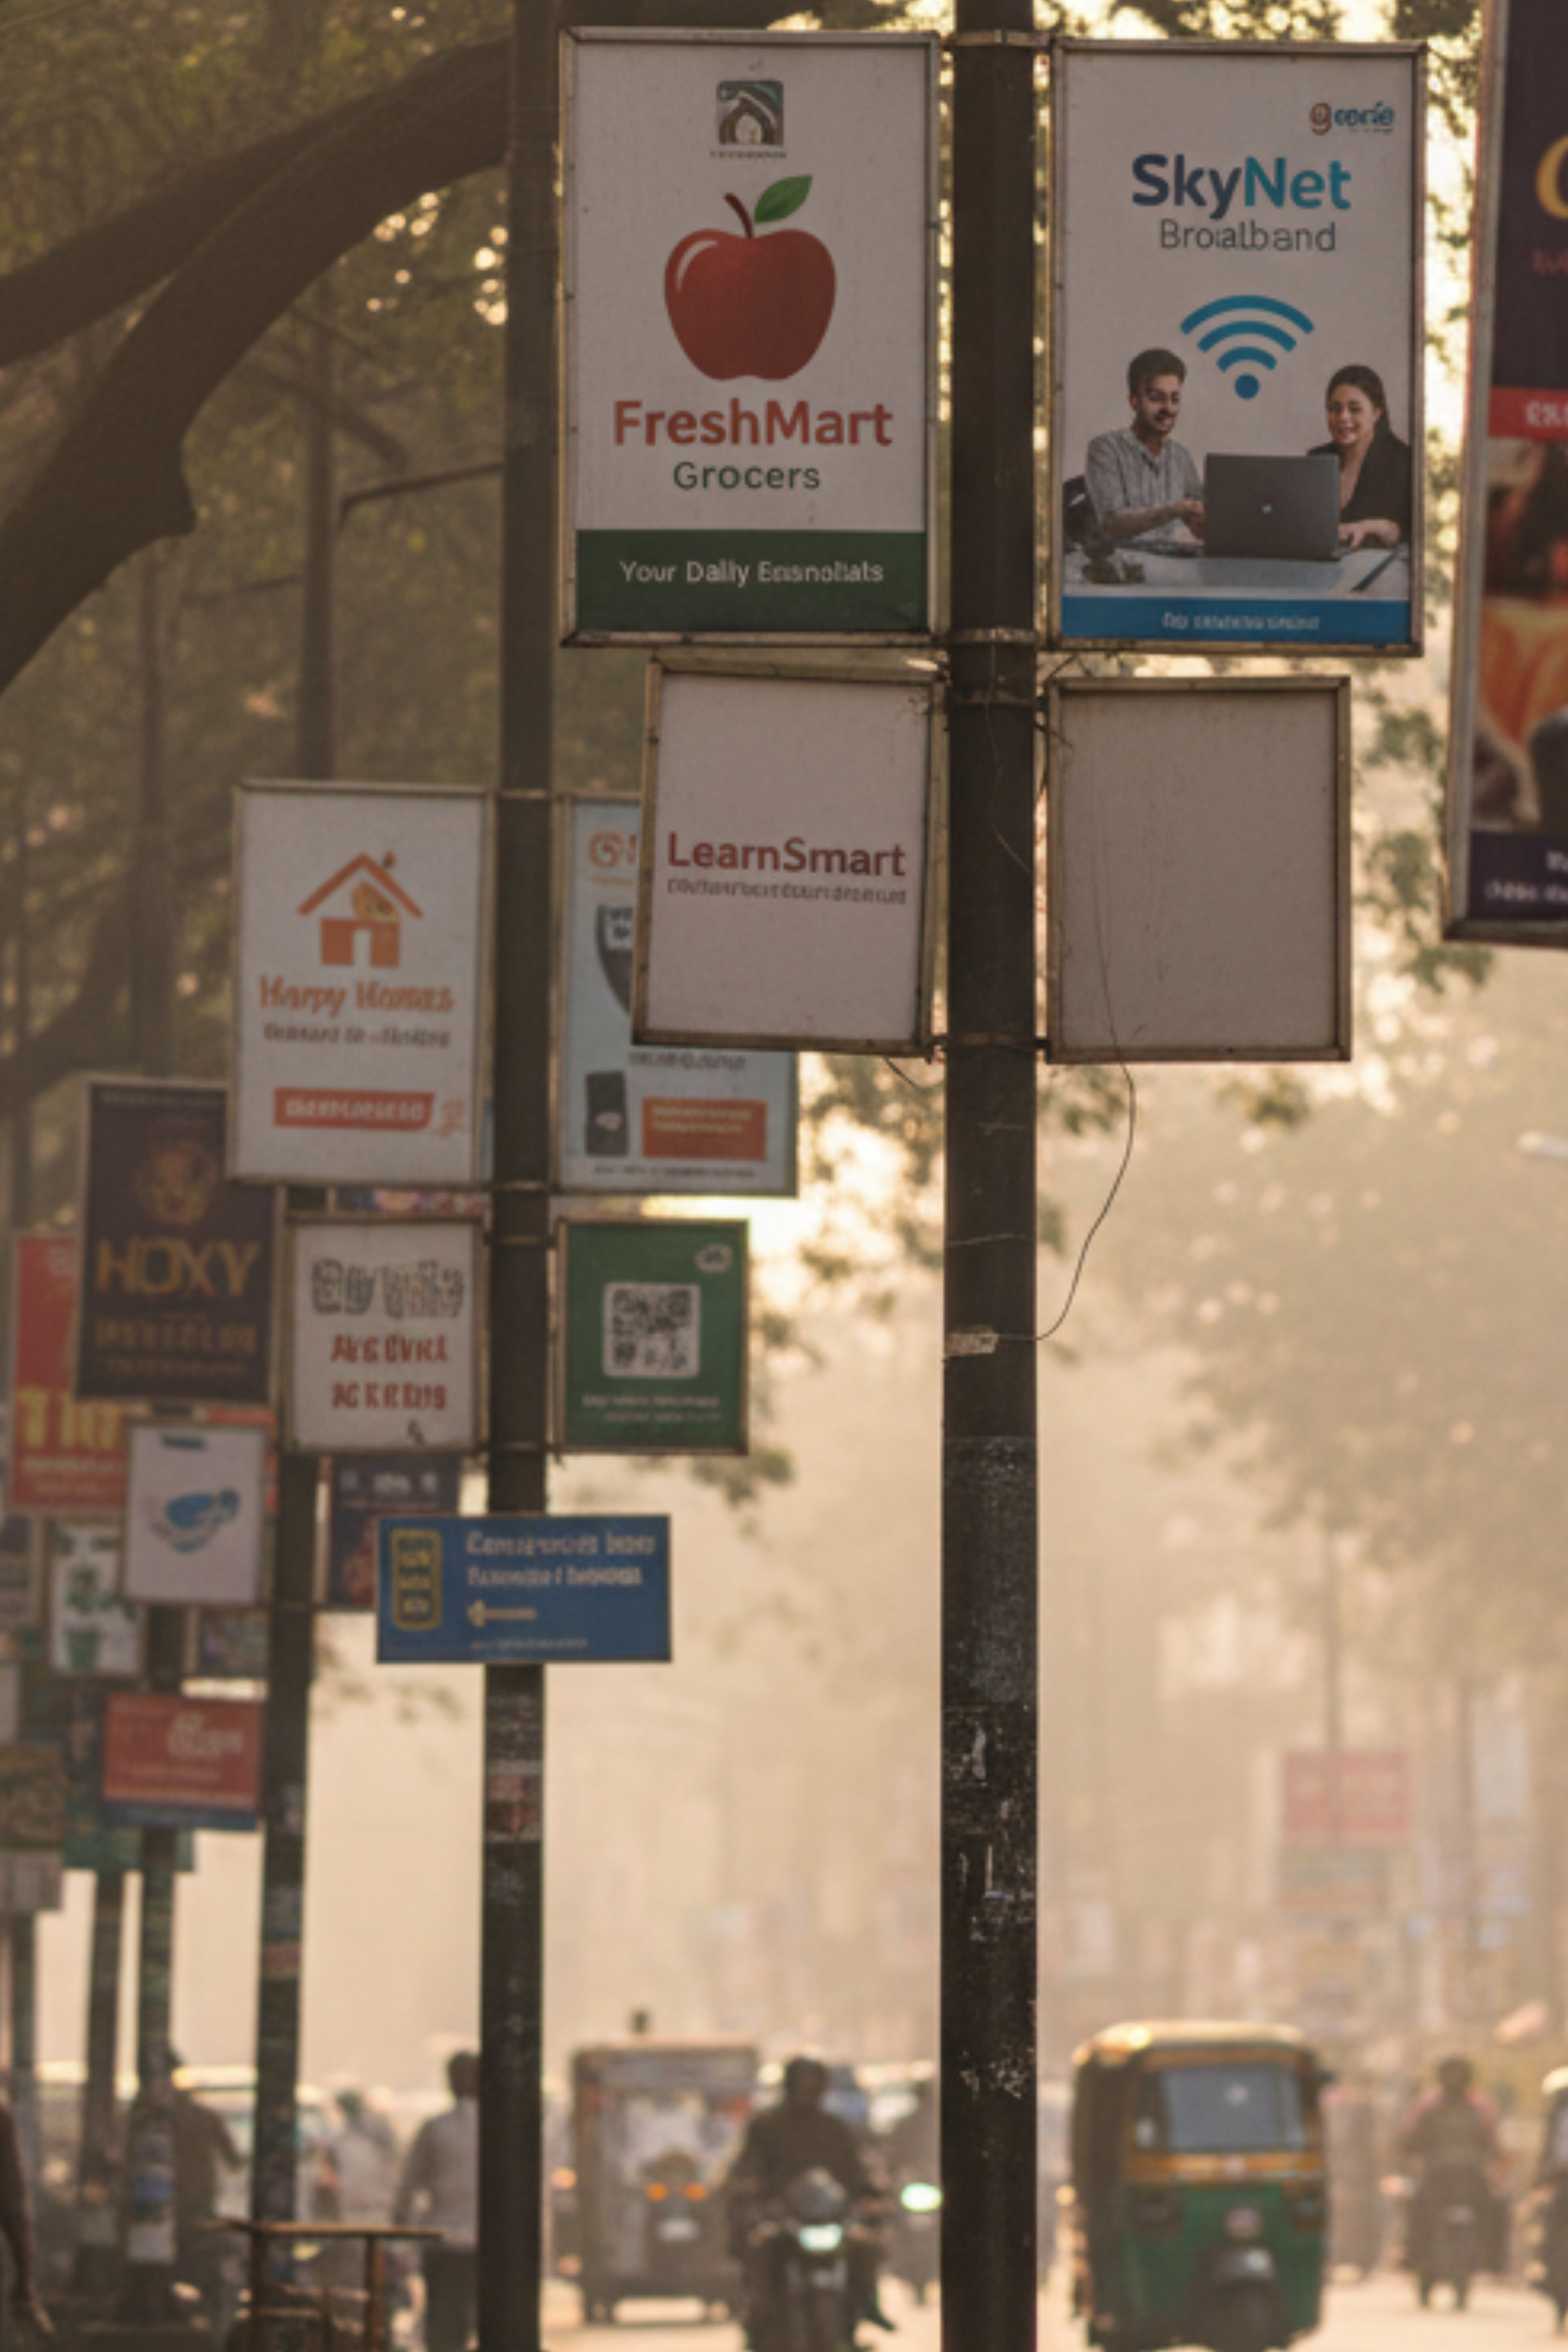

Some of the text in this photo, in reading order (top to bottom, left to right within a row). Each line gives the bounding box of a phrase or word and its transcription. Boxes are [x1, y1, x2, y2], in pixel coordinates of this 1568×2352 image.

[1132, 154, 1350, 220] SkyNet
[614, 398, 893, 446] FreshMart
[674, 462, 820, 490] Grocers
[619, 561, 676, 582] Your
[668, 832, 906, 877] LearnSmart
